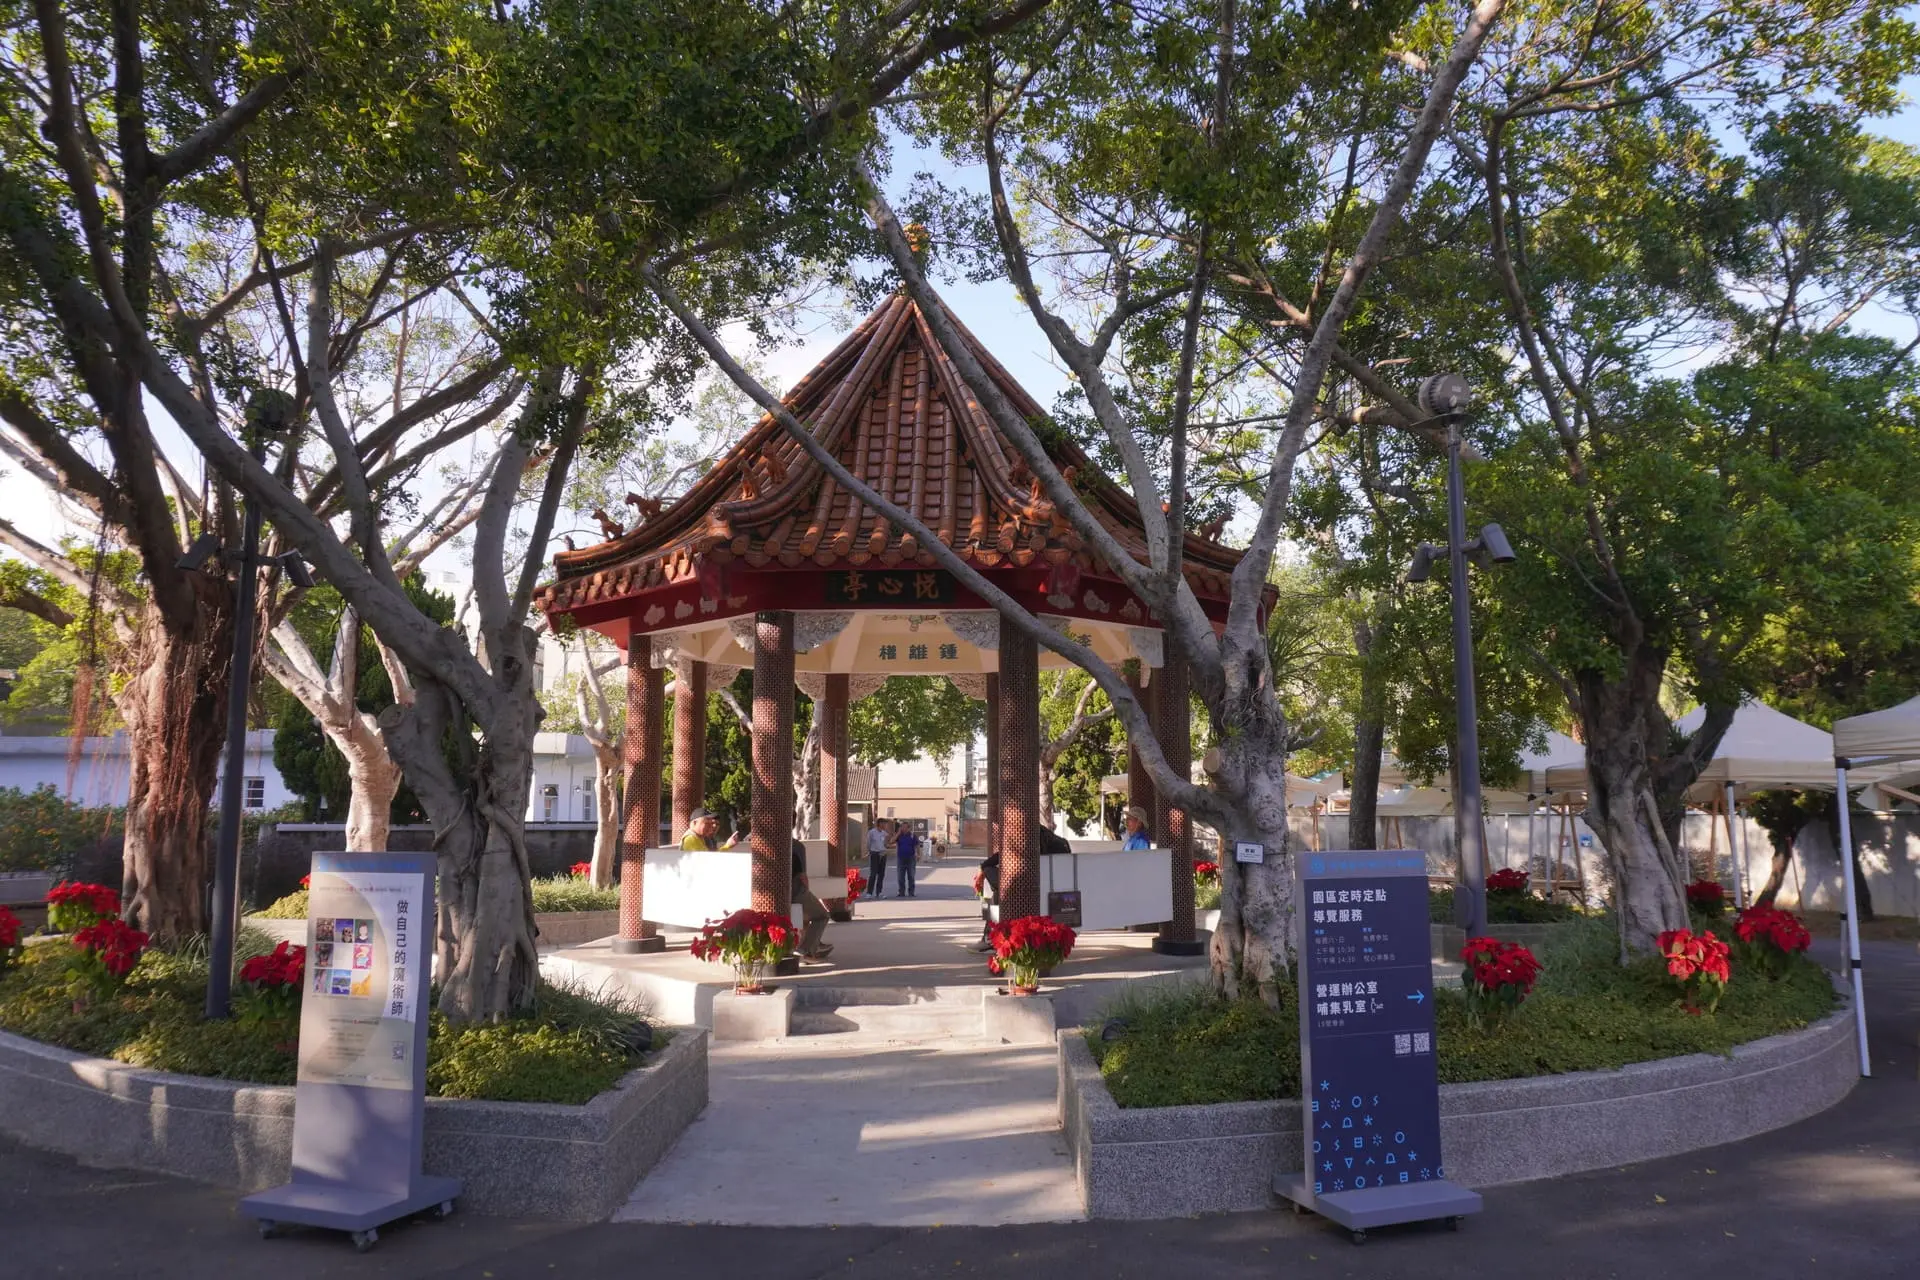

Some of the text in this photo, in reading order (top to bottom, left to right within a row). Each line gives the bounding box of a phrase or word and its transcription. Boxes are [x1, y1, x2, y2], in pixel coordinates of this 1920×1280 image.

[1313, 888, 1387, 904] 園區定時定點
[1313, 909, 1363, 923] 導覽服務
[391, 899, 409, 1016] 做自己的魔術師
[1316, 981, 1378, 998] 營運辦公室
[1316, 1000, 1366, 1016] 哺集乳室
